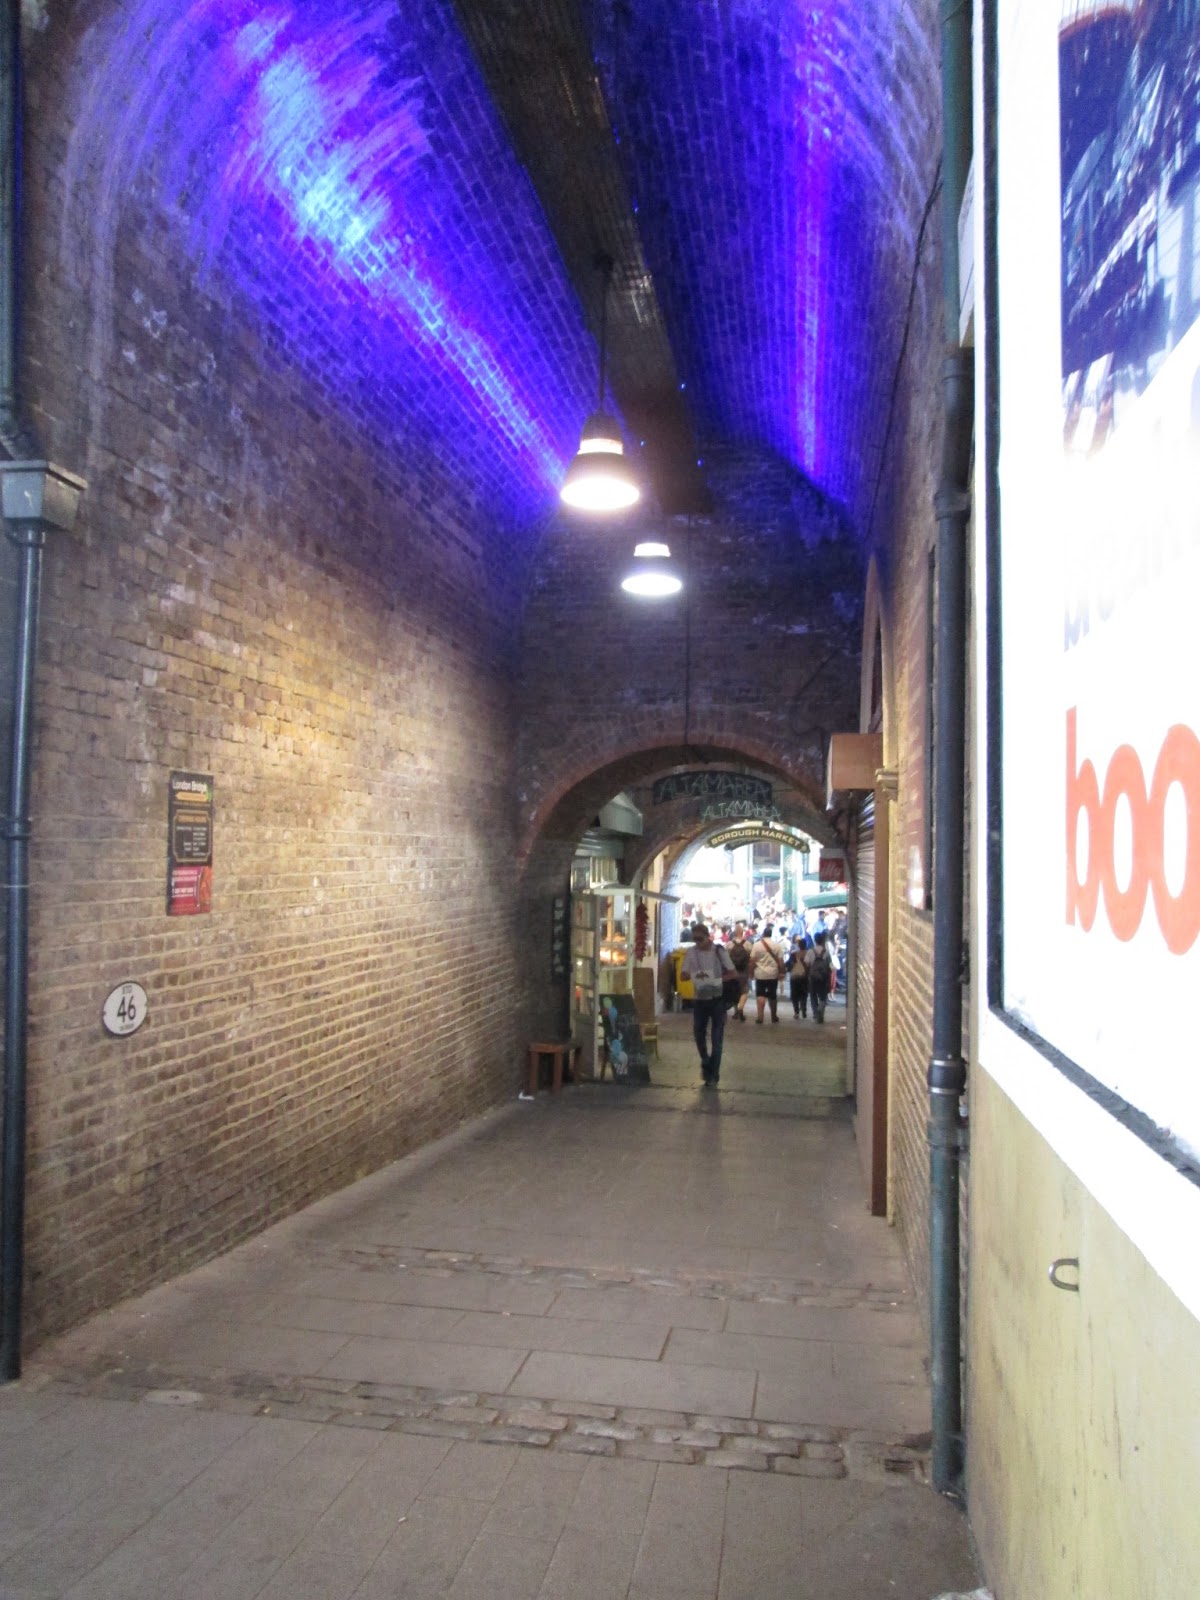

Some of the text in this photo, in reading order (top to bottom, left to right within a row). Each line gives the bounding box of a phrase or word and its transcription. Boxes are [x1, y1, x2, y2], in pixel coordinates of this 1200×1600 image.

[172, 778, 207, 794] London Bridge
[711, 829, 760, 845] BOROUGH
[761, 829, 801, 847] MARKET
[117, 993, 136, 1023] 46
